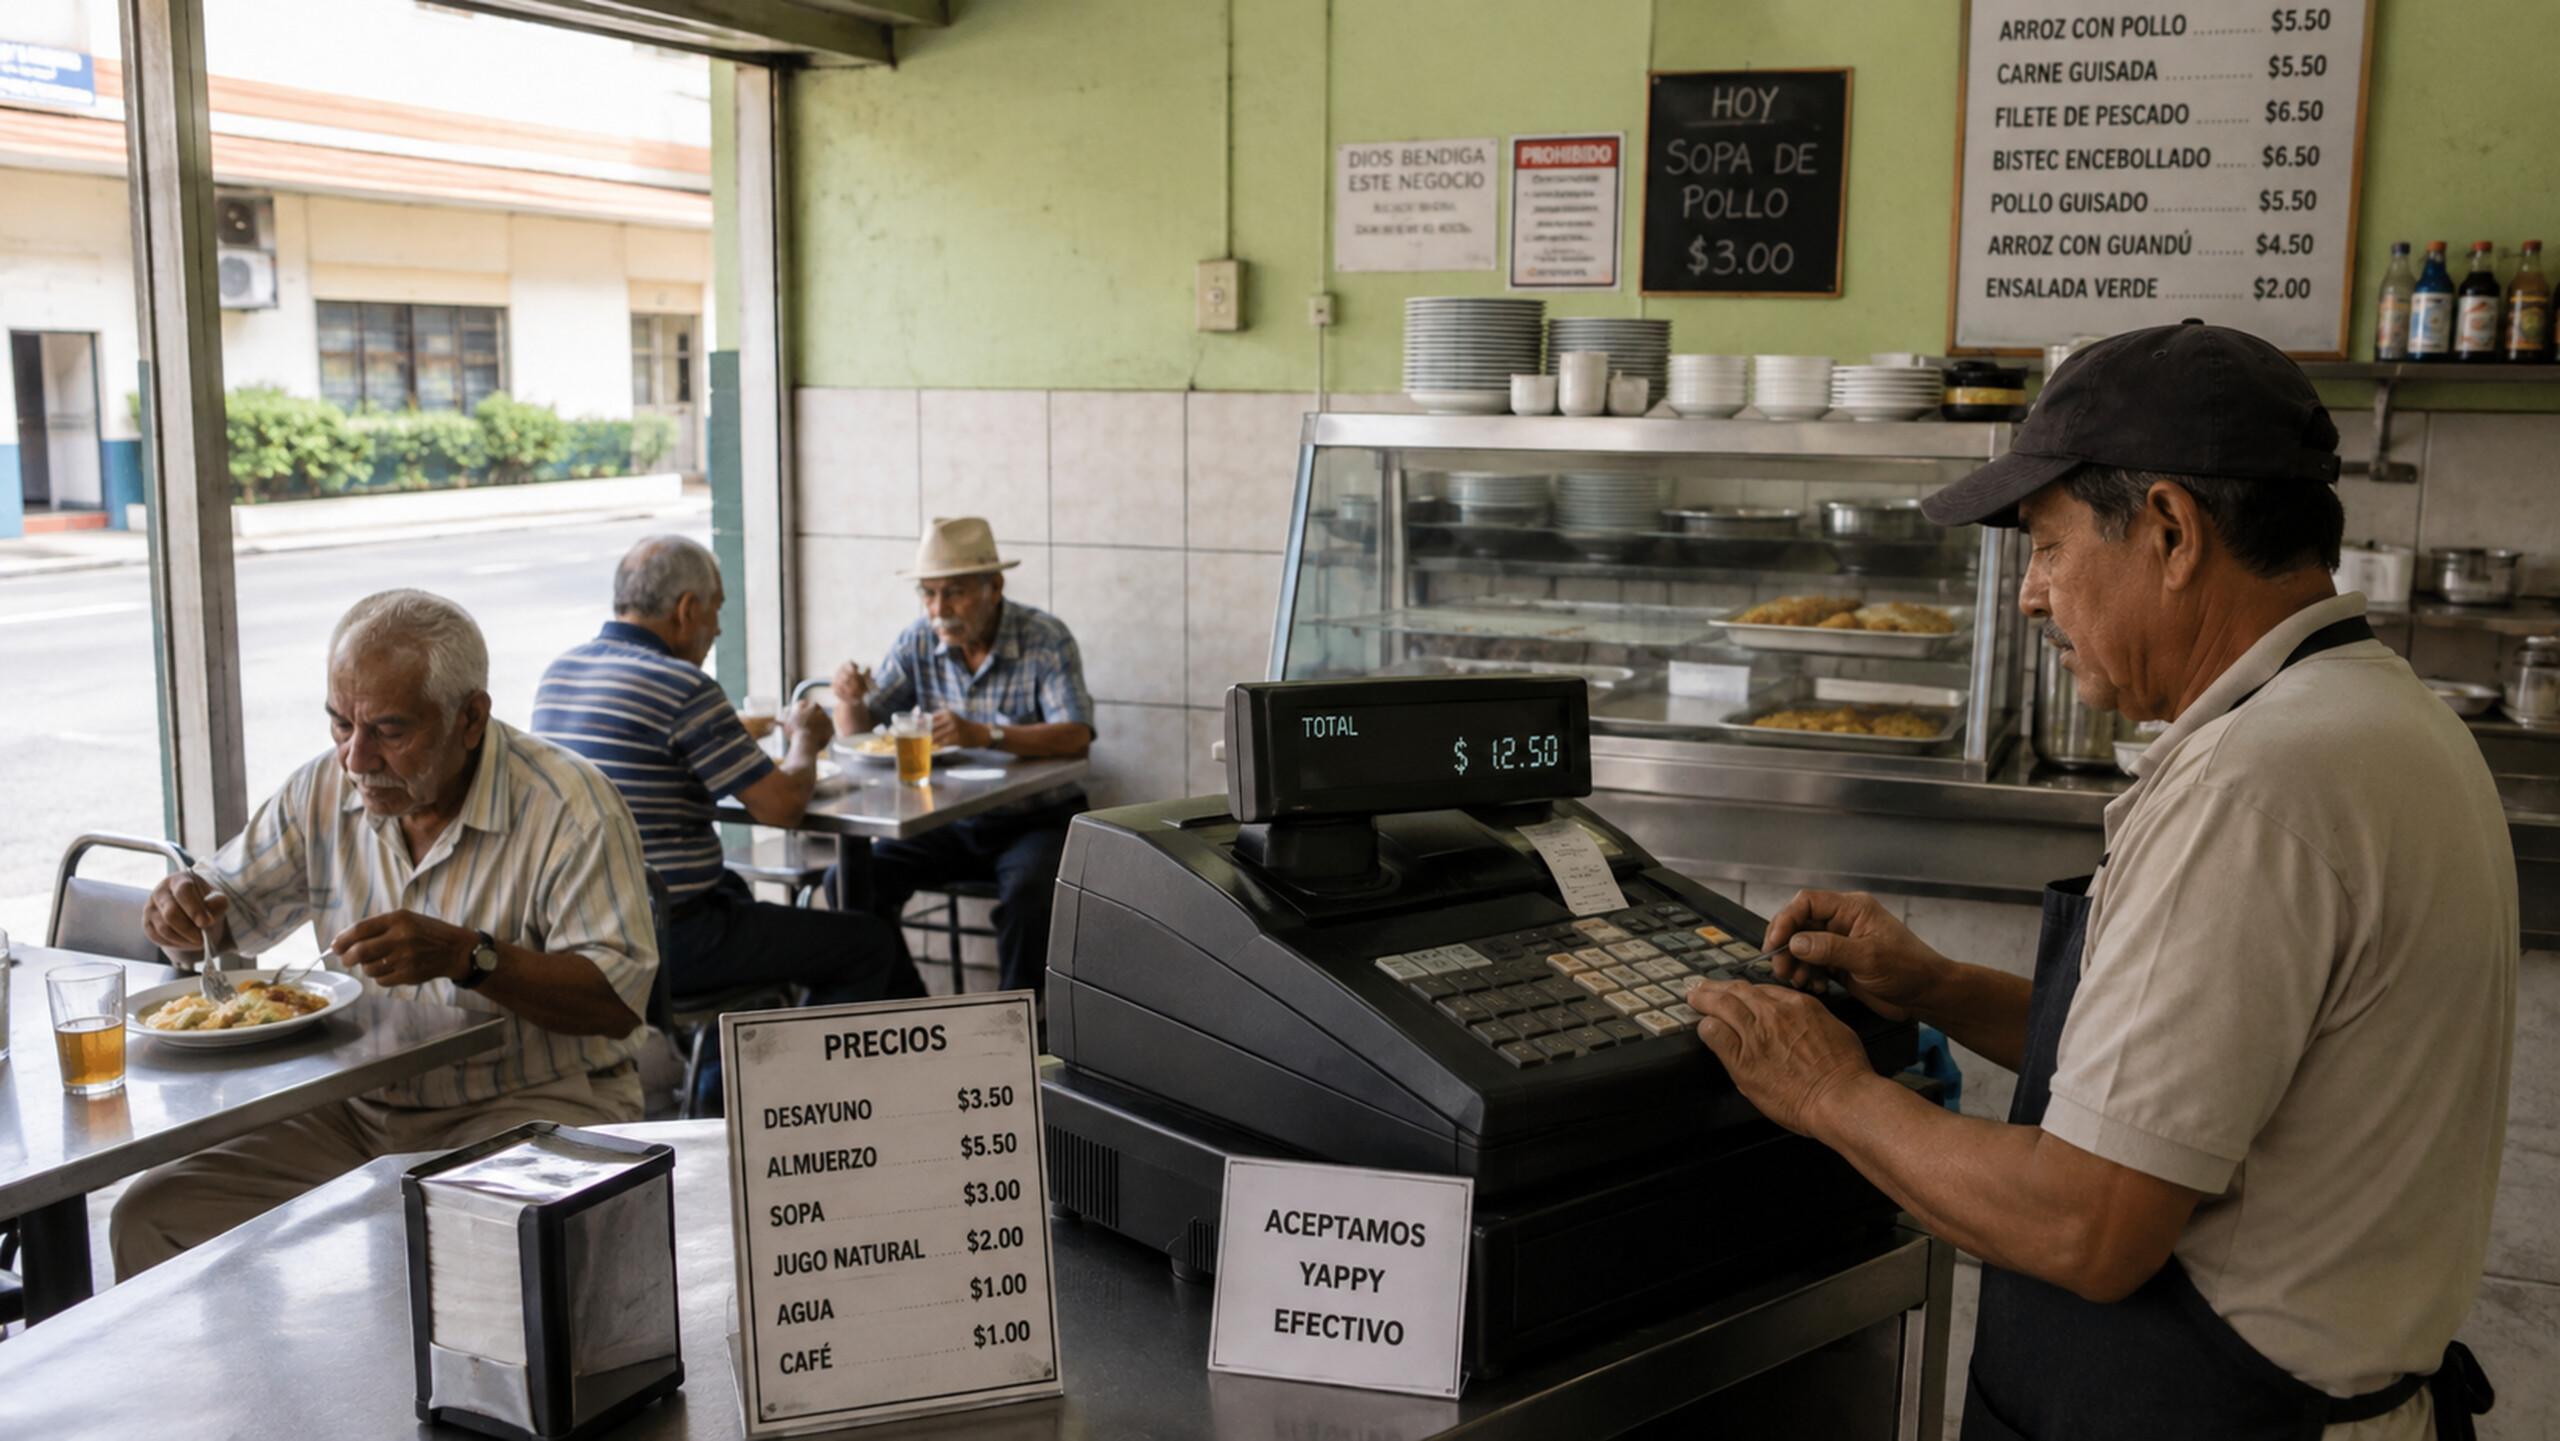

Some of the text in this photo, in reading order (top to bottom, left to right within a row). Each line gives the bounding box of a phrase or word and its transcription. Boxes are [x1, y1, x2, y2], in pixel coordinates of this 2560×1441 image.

[2000, 9, 2330, 40] ARROZ CON POLLO $5.50
[1998, 55, 2327, 84] CARNE GUISADA $5.50
[1712, 86, 1779, 124] HOY
[1996, 100, 2323, 127] FILETE DE PESCADO $6.50
[1349, 147, 1485, 168] DIOS BENDIGA
[1521, 145, 1611, 164] PROHIBIDO
[1665, 139, 1817, 175] SOPA DE
[1993, 145, 2320, 170] BISTEC ENCEBOLLADO $6.50
[1349, 171, 1485, 192] ESTE NEGOCIO
[1683, 184, 1788, 220] POLLO
[1991, 190, 2317, 213] POLLO GUISADO $5.50
[1688, 235, 1793, 275] $3.00
[1988, 230, 2314, 256] ARROZ CON GUANDÚ $4.50
[1987, 277, 2311, 300] ENSALADA VERDE $2.00
[1302, 716, 1358, 737] TOTAL
[1493, 735, 1557, 769] 12.50
[825, 1025, 946, 1060] PRECIOS
[764, 1086, 1013, 1129] DESAYUNO $3.50
[767, 1133, 1017, 1178] ALMUERZO $5.50
[770, 1179, 1020, 1227] SOPA $3.00
[1265, 1209, 1425, 1247] ACEPTAMOS
[774, 1226, 1023, 1276] JUGO NATURAL $2.00
[1300, 1262, 1385, 1293] YAPPY
[777, 1273, 1026, 1325] AGUA $1.00
[1275, 1309, 1404, 1345] EFECTIVO
[780, 1320, 1030, 1374] CAFÉ $1.00
